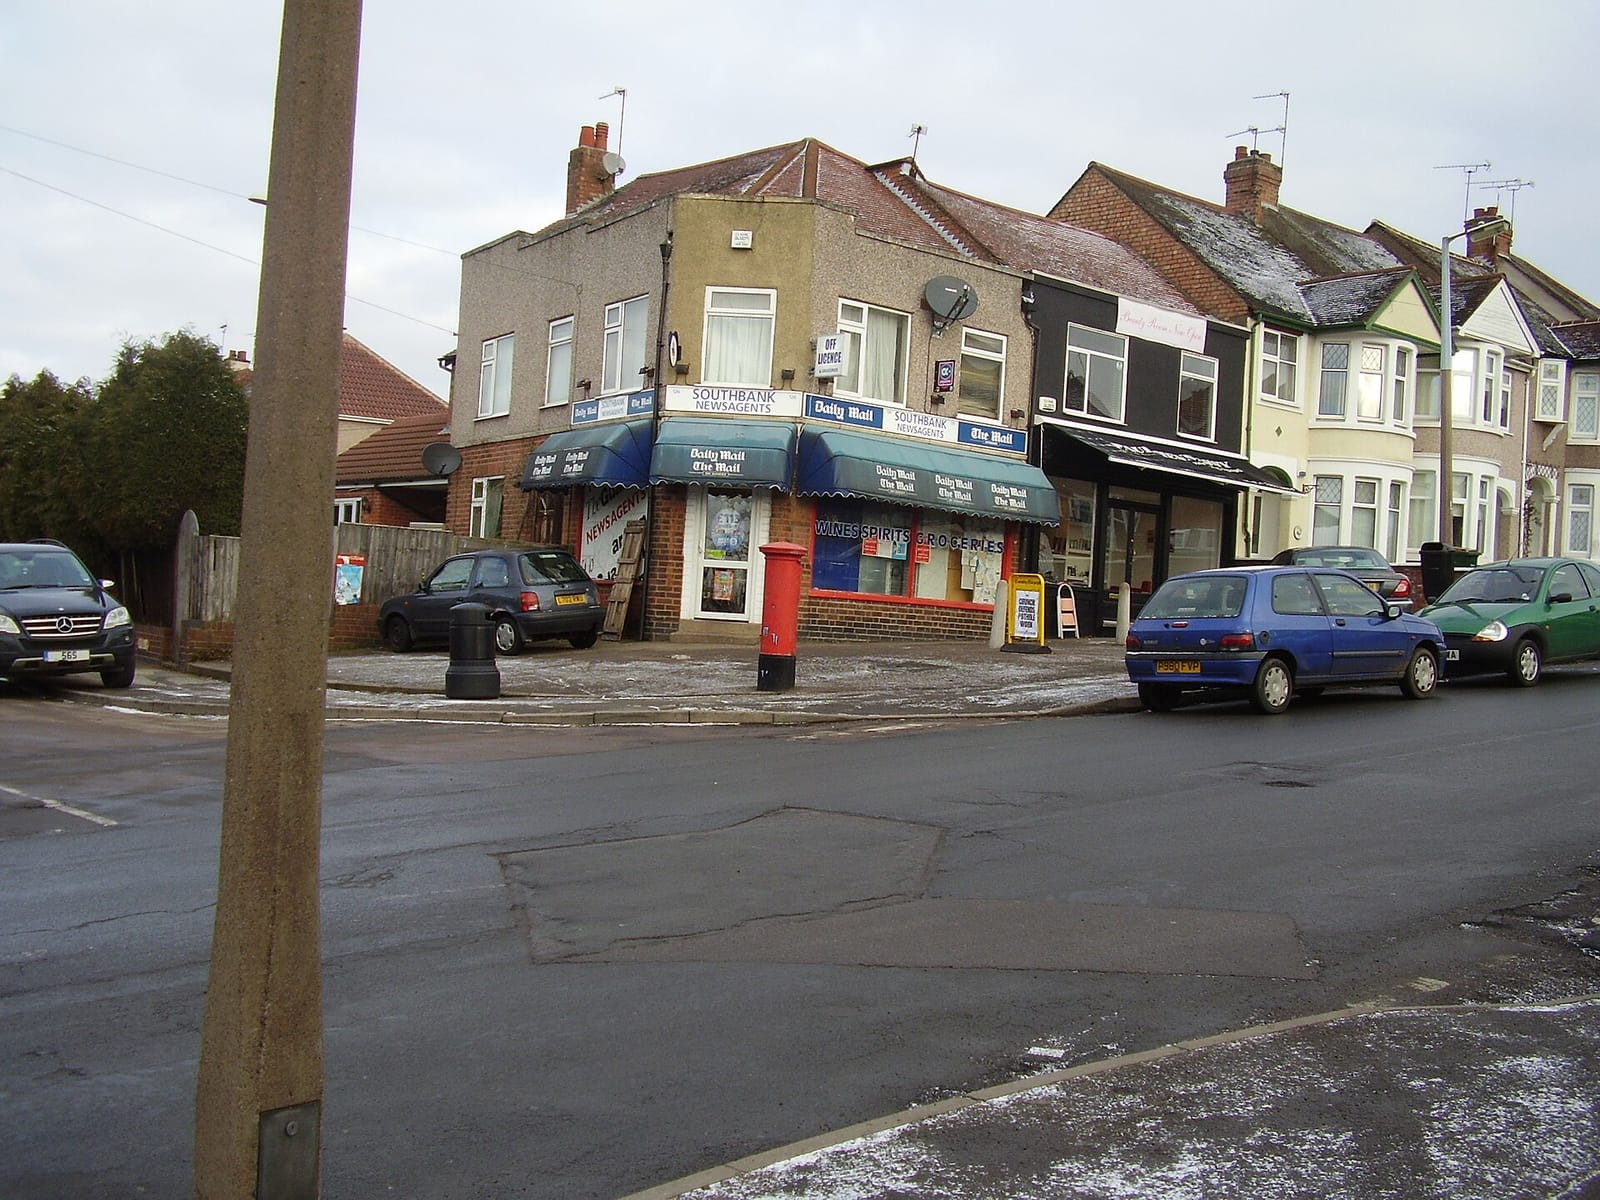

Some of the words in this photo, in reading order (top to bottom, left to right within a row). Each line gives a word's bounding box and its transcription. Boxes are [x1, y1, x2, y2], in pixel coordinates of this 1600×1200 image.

[825, 338, 837, 350] OFF
[817, 351, 842, 365] LICENCE
[692, 388, 776, 403] SOUTHBANK
[695, 401, 772, 413] NEWSAGENTS
[815, 400, 845, 420] Daily
[848, 406, 874, 422] Mail
[894, 411, 947, 430] SOUTHBANK
[896, 423, 945, 439] NEWSAGENTS
[970, 427, 989, 441] The
[991, 431, 1014, 445] Mail
[690, 448, 719, 462] Daily
[720, 450, 746, 461] Mail
[692, 461, 713, 472] The
[715, 462, 741, 473] Mail
[876, 465, 897, 477] Daily
[897, 469, 916, 480] Mail
[880, 478, 895, 490] The
[895, 481, 915, 492] Mail
[935, 474, 955, 489] Daily
[955, 479, 974, 490] Mail
[938, 488, 953, 498] The
[954, 490, 972, 501] Mail
[991, 483, 1010, 497] Daily
[1010, 487, 1028, 498] Mail
[994, 496, 1009, 507] The
[1009, 498, 1026, 509] Mail
[586, 491, 647, 545] NEWSAGENTS
[815, 520, 861, 538] WINES
[861, 525, 911, 544] SPIRITS
[915, 532, 1006, 554] GROCERIES
